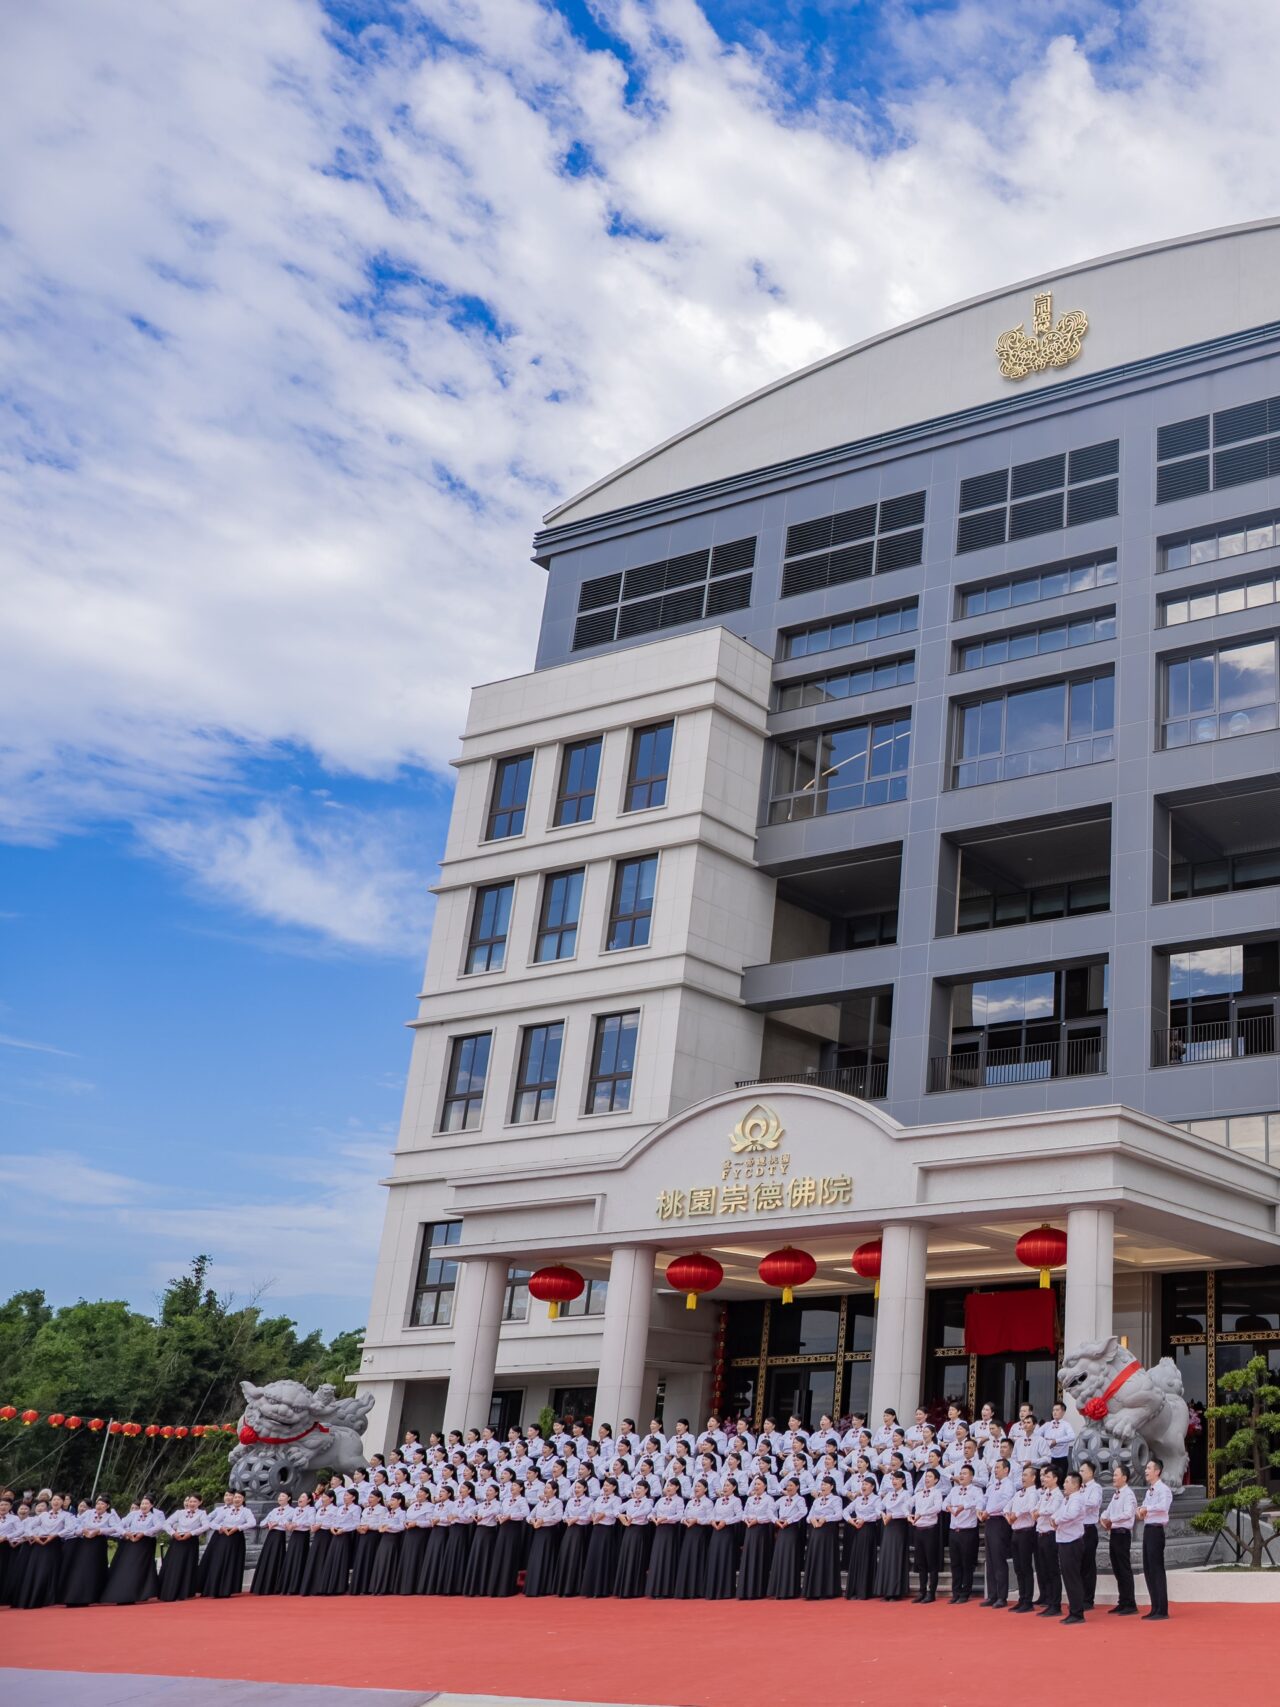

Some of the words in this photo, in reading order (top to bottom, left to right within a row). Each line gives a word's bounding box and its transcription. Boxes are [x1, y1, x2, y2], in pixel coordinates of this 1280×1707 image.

[721, 1164, 789, 1181] FYCDTY
[656, 1174, 853, 1220] 桃園崇德佛院
